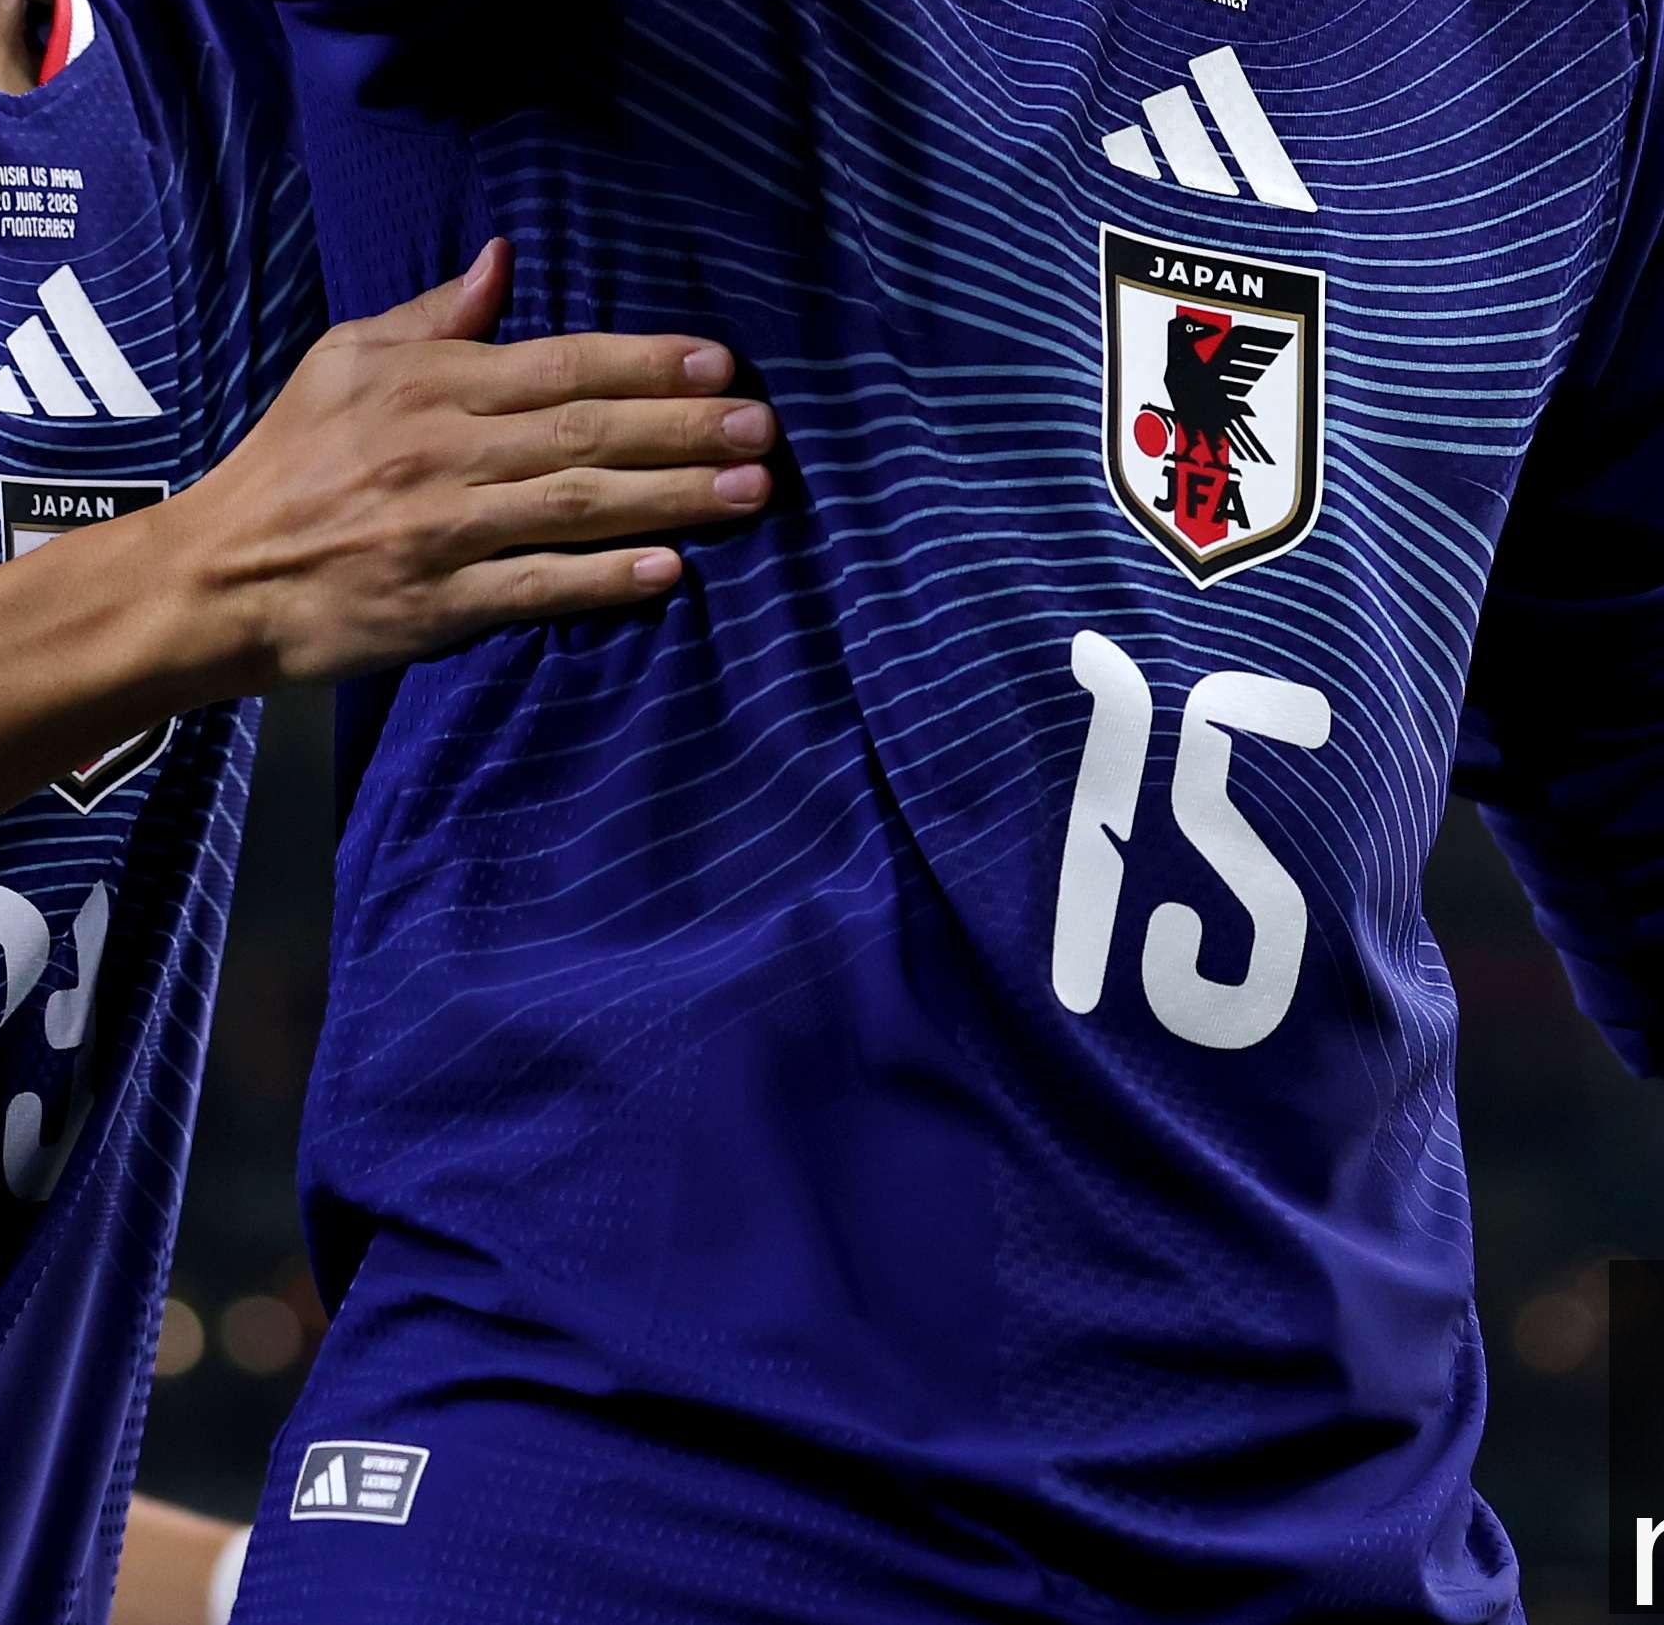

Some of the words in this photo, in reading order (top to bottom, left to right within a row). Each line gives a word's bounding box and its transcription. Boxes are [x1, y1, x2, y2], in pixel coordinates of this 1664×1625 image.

[50, 168, 84, 190] JAPAN
[15, 191, 44, 212] JUNE
[47, 192, 78, 214] 2026
[1, 216, 75, 239] MONTERREY
[1149, 256, 1264, 299] JAPAN
[30, 494, 115, 519] JAPAN
[1153, 467, 1251, 530] JFA
[1052, 629, 1332, 1049] 15
